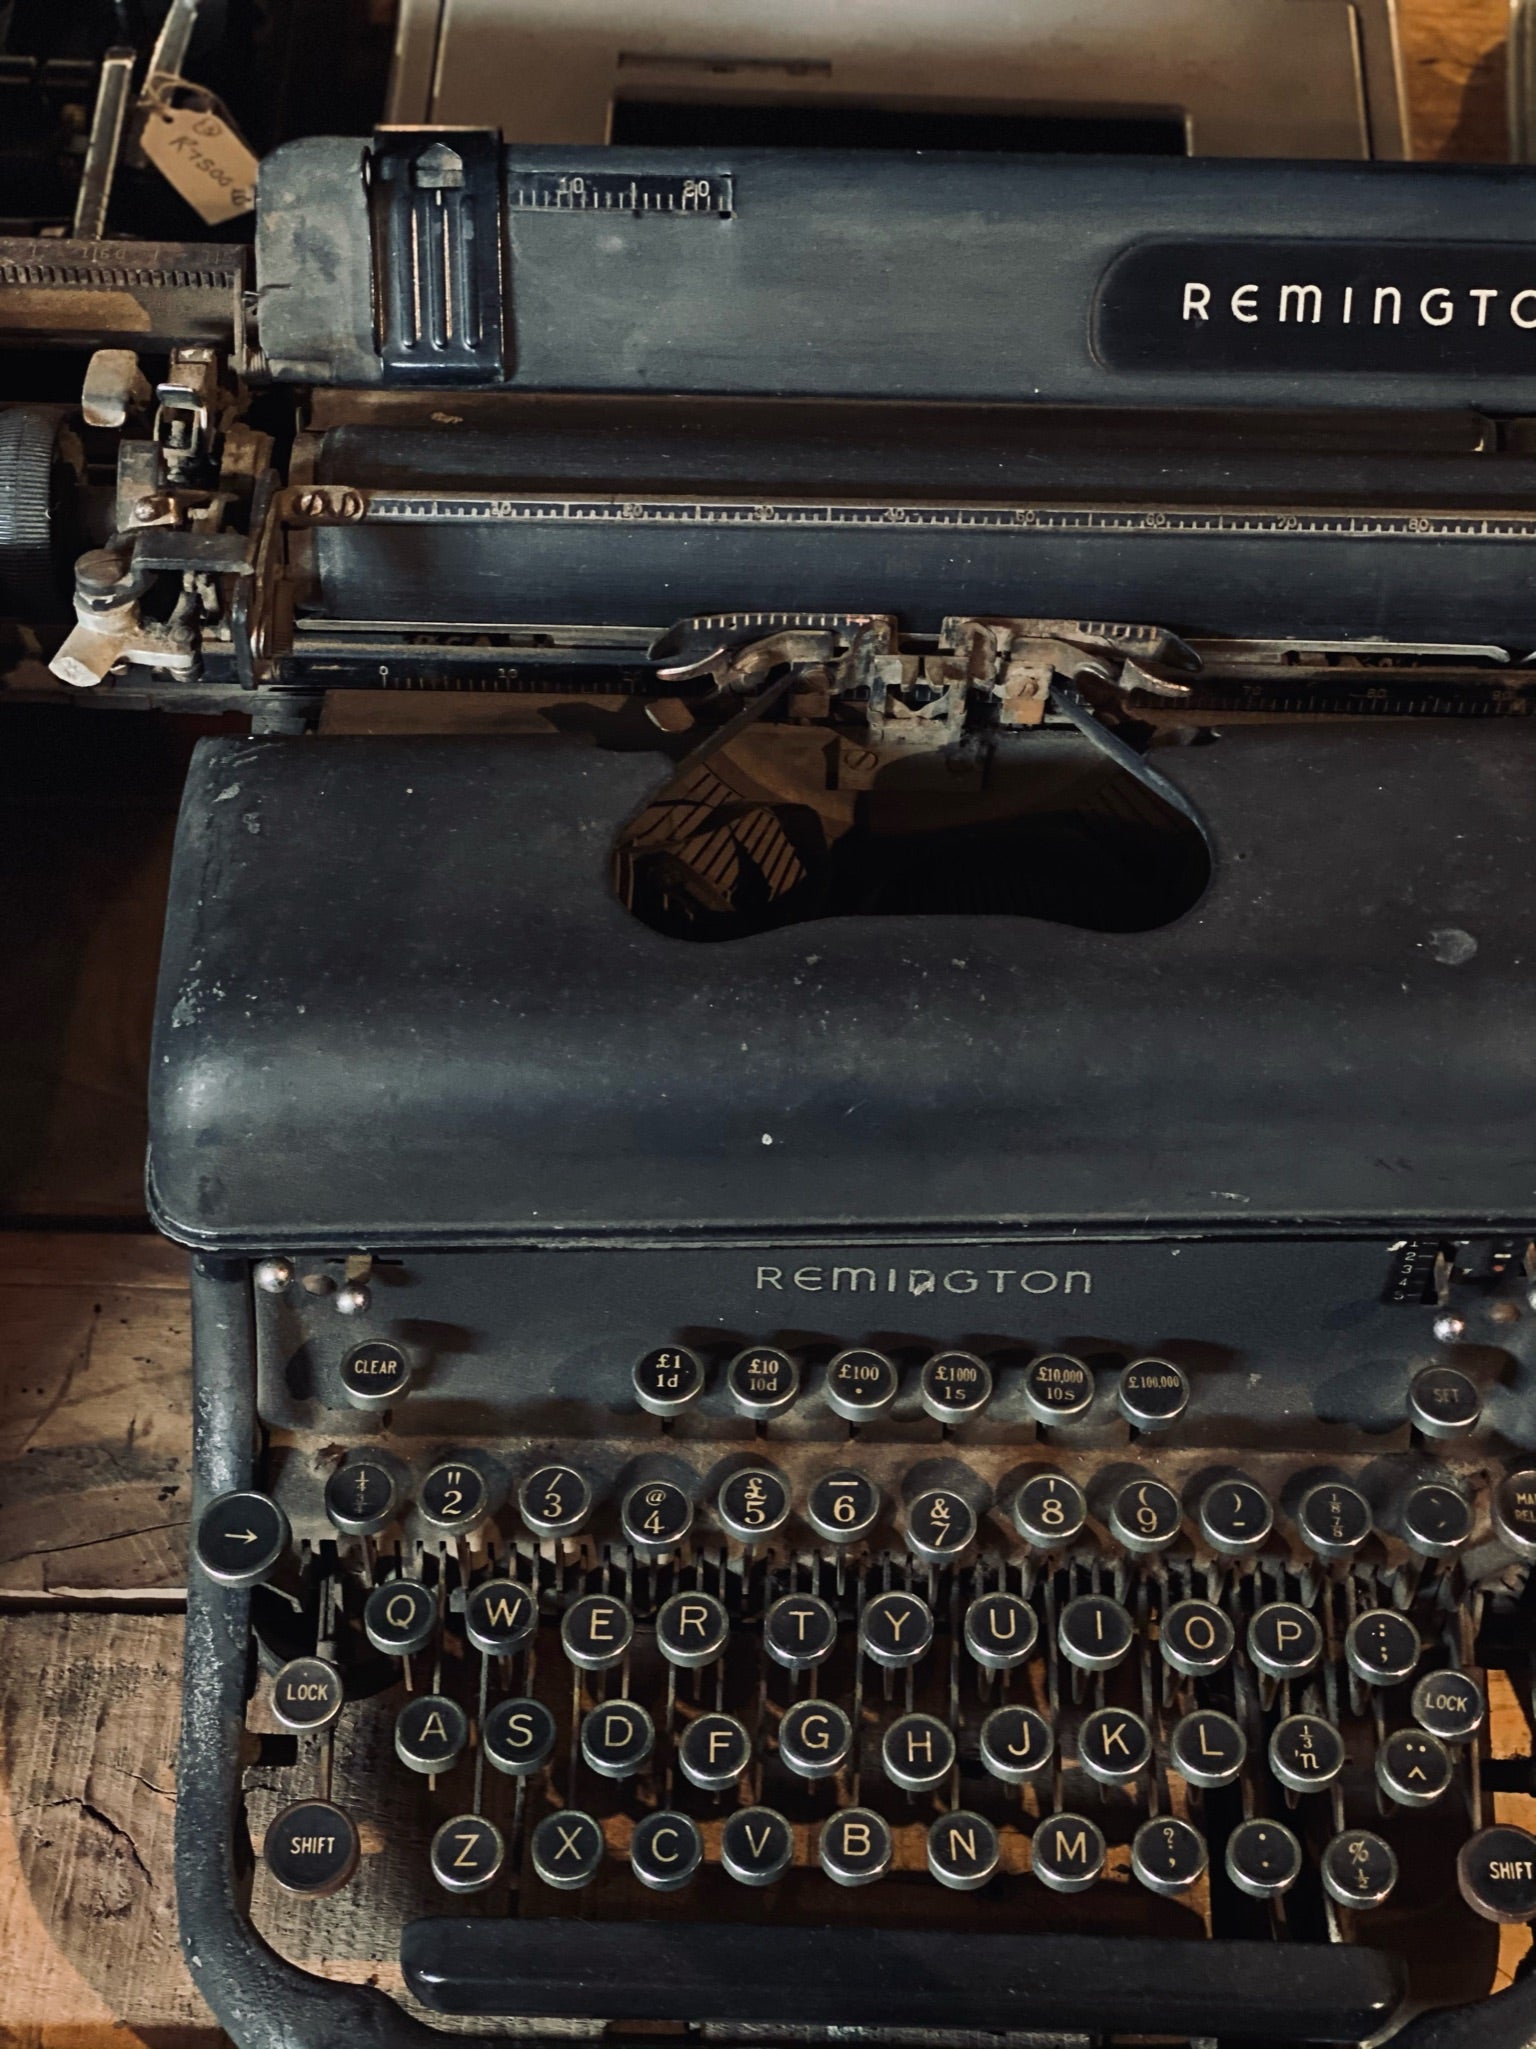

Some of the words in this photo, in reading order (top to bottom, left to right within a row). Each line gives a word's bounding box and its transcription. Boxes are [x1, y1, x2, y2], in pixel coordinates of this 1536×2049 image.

[557, 176, 586, 194] 10
[683, 179, 711, 198] 20
[1145, 512, 1166, 525] 60
[1408, 518, 1430, 531] 80
[1401, 1264, 1413, 1274] 3
[1404, 1251, 1417, 1261] 2
[756, 1266, 1093, 1296] REMINGTON
[1398, 1278, 1408, 1287] 4
[354, 1359, 398, 1375] CLEAR
[747, 1358, 780, 1375] £10
[837, 1364, 880, 1381] £100
[934, 1365, 978, 1383] £1000
[1035, 1366, 1084, 1384] £10,000
[749, 1377, 777, 1392] 10d
[1432, 1388, 1459, 1403] SET
[645, 1489, 667, 1506] @
[744, 1477, 767, 1500] £
[1516, 1492, 1536, 1505] MA
[441, 1490, 463, 1515] 2
[543, 1493, 562, 1518] 3
[744, 1501, 766, 1524] 5
[833, 1495, 856, 1522] 6
[930, 1498, 951, 1519] &
[1041, 1499, 1065, 1525] 8
[643, 1510, 665, 1534] 4
[930, 1520, 951, 1546] 7
[1136, 1507, 1158, 1533] 9
[386, 1594, 416, 1629] Q
[485, 1597, 522, 1627] W
[589, 1608, 614, 1640] E
[679, 1605, 708, 1636] R
[989, 1608, 1016, 1640] U
[788, 1610, 815, 1641] T
[884, 1610, 911, 1642] Y
[1096, 1610, 1103, 1640] I
[1184, 1616, 1215, 1650] O
[1276, 1619, 1302, 1651] P
[286, 1683, 329, 1701] LOCK
[1425, 1693, 1468, 1713] LOCK
[419, 1711, 447, 1742] A
[506, 1713, 533, 1748] S
[604, 1715, 633, 1747] D
[801, 1714, 830, 1749] G
[1007, 1721, 1030, 1756] J
[1102, 1723, 1130, 1755] K
[1199, 1723, 1225, 1756] L
[709, 1731, 733, 1763] F
[907, 1730, 932, 1763] H
[290, 1836, 336, 1855] SHIFT
[453, 1833, 480, 1867] Z
[554, 1826, 583, 1860] X
[651, 1828, 679, 1863] C
[744, 1824, 771, 1857] V
[843, 1823, 871, 1856] B
[949, 1828, 977, 1861] N
[1055, 1830, 1087, 1864] M
[1348, 1842, 1369, 1863] %
[1489, 1861, 1533, 1880] SHIFT
